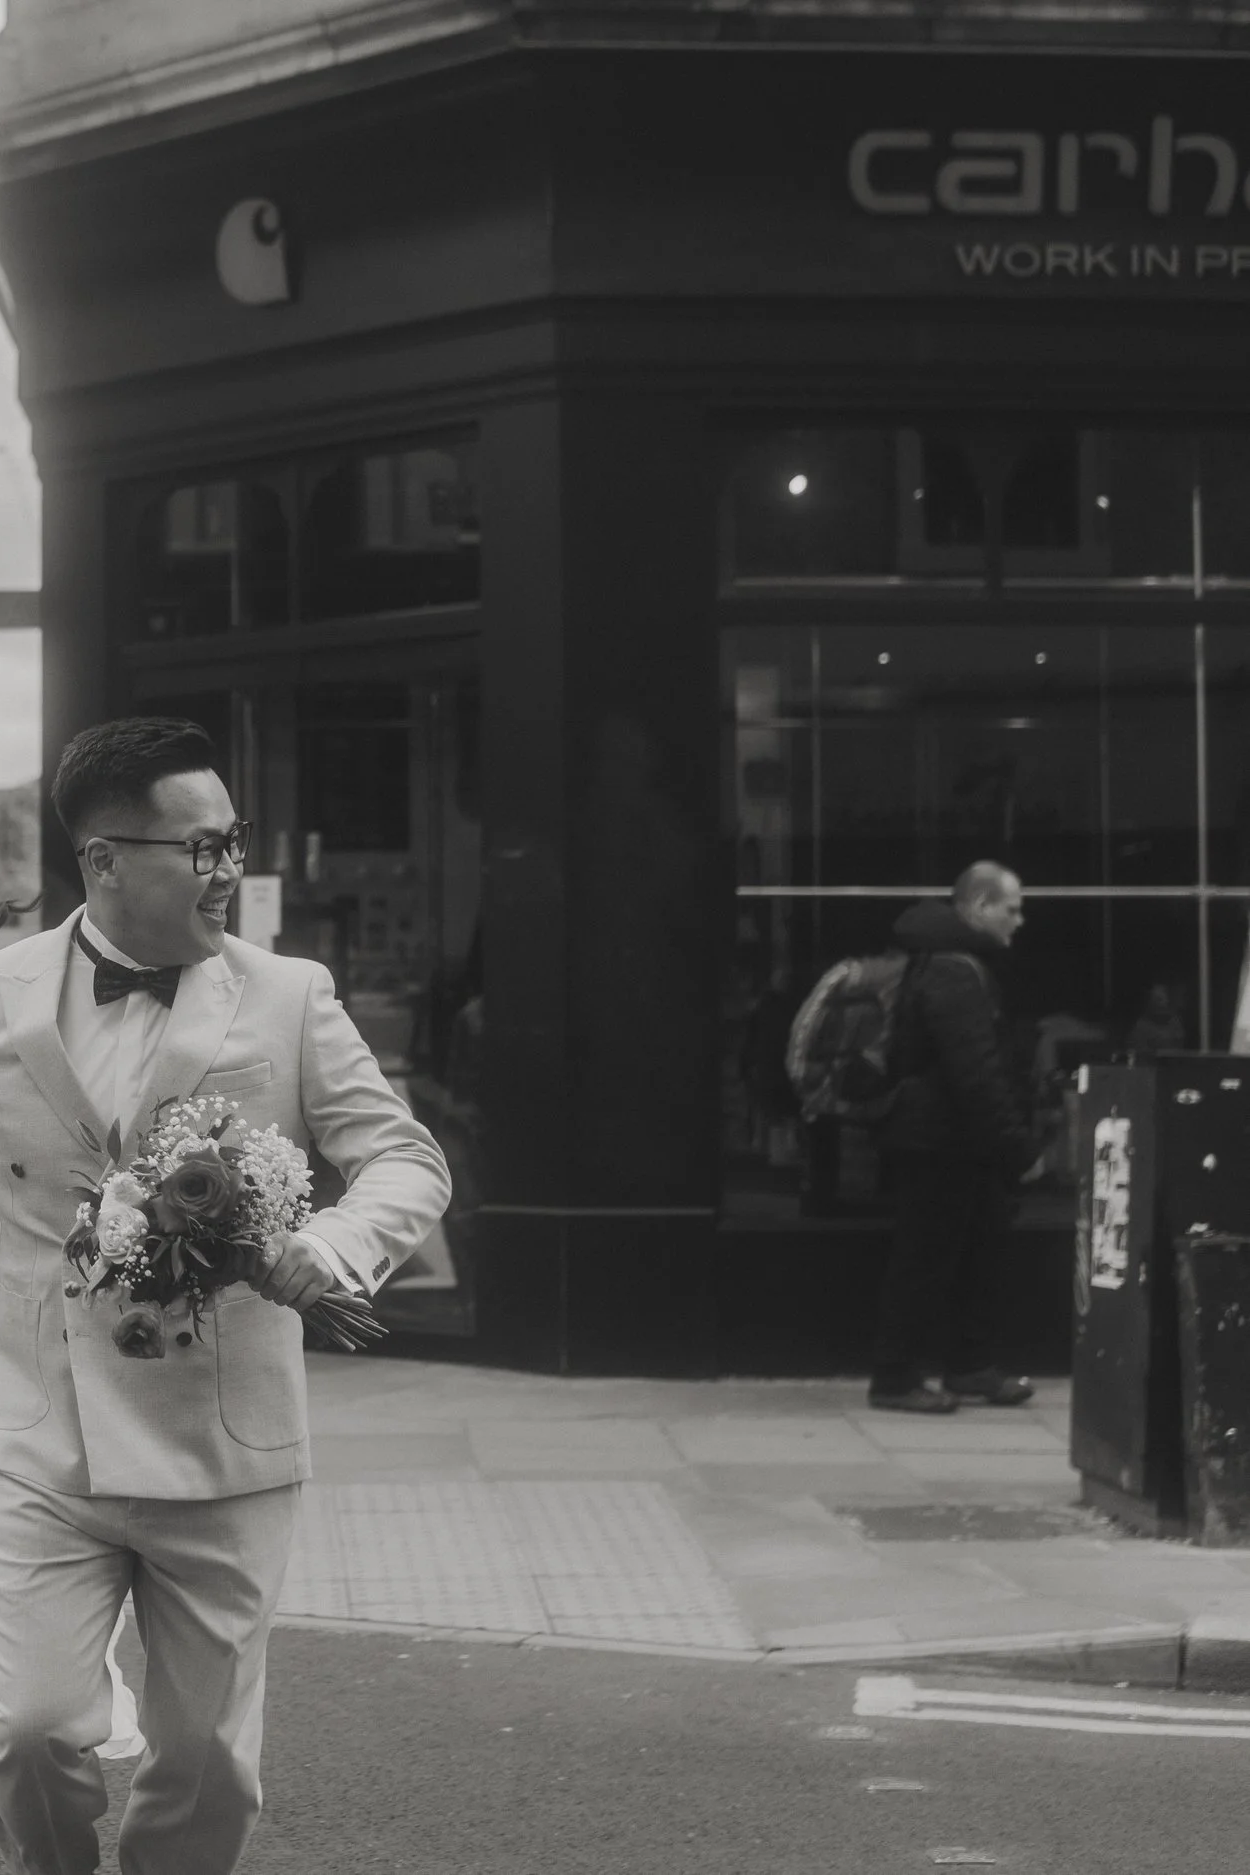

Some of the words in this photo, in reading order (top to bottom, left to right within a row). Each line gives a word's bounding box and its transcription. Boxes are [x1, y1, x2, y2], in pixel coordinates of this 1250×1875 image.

[849, 115, 1250, 214] carh
[955, 243, 1118, 277] WORK
[1130, 244, 1180, 277] IN
